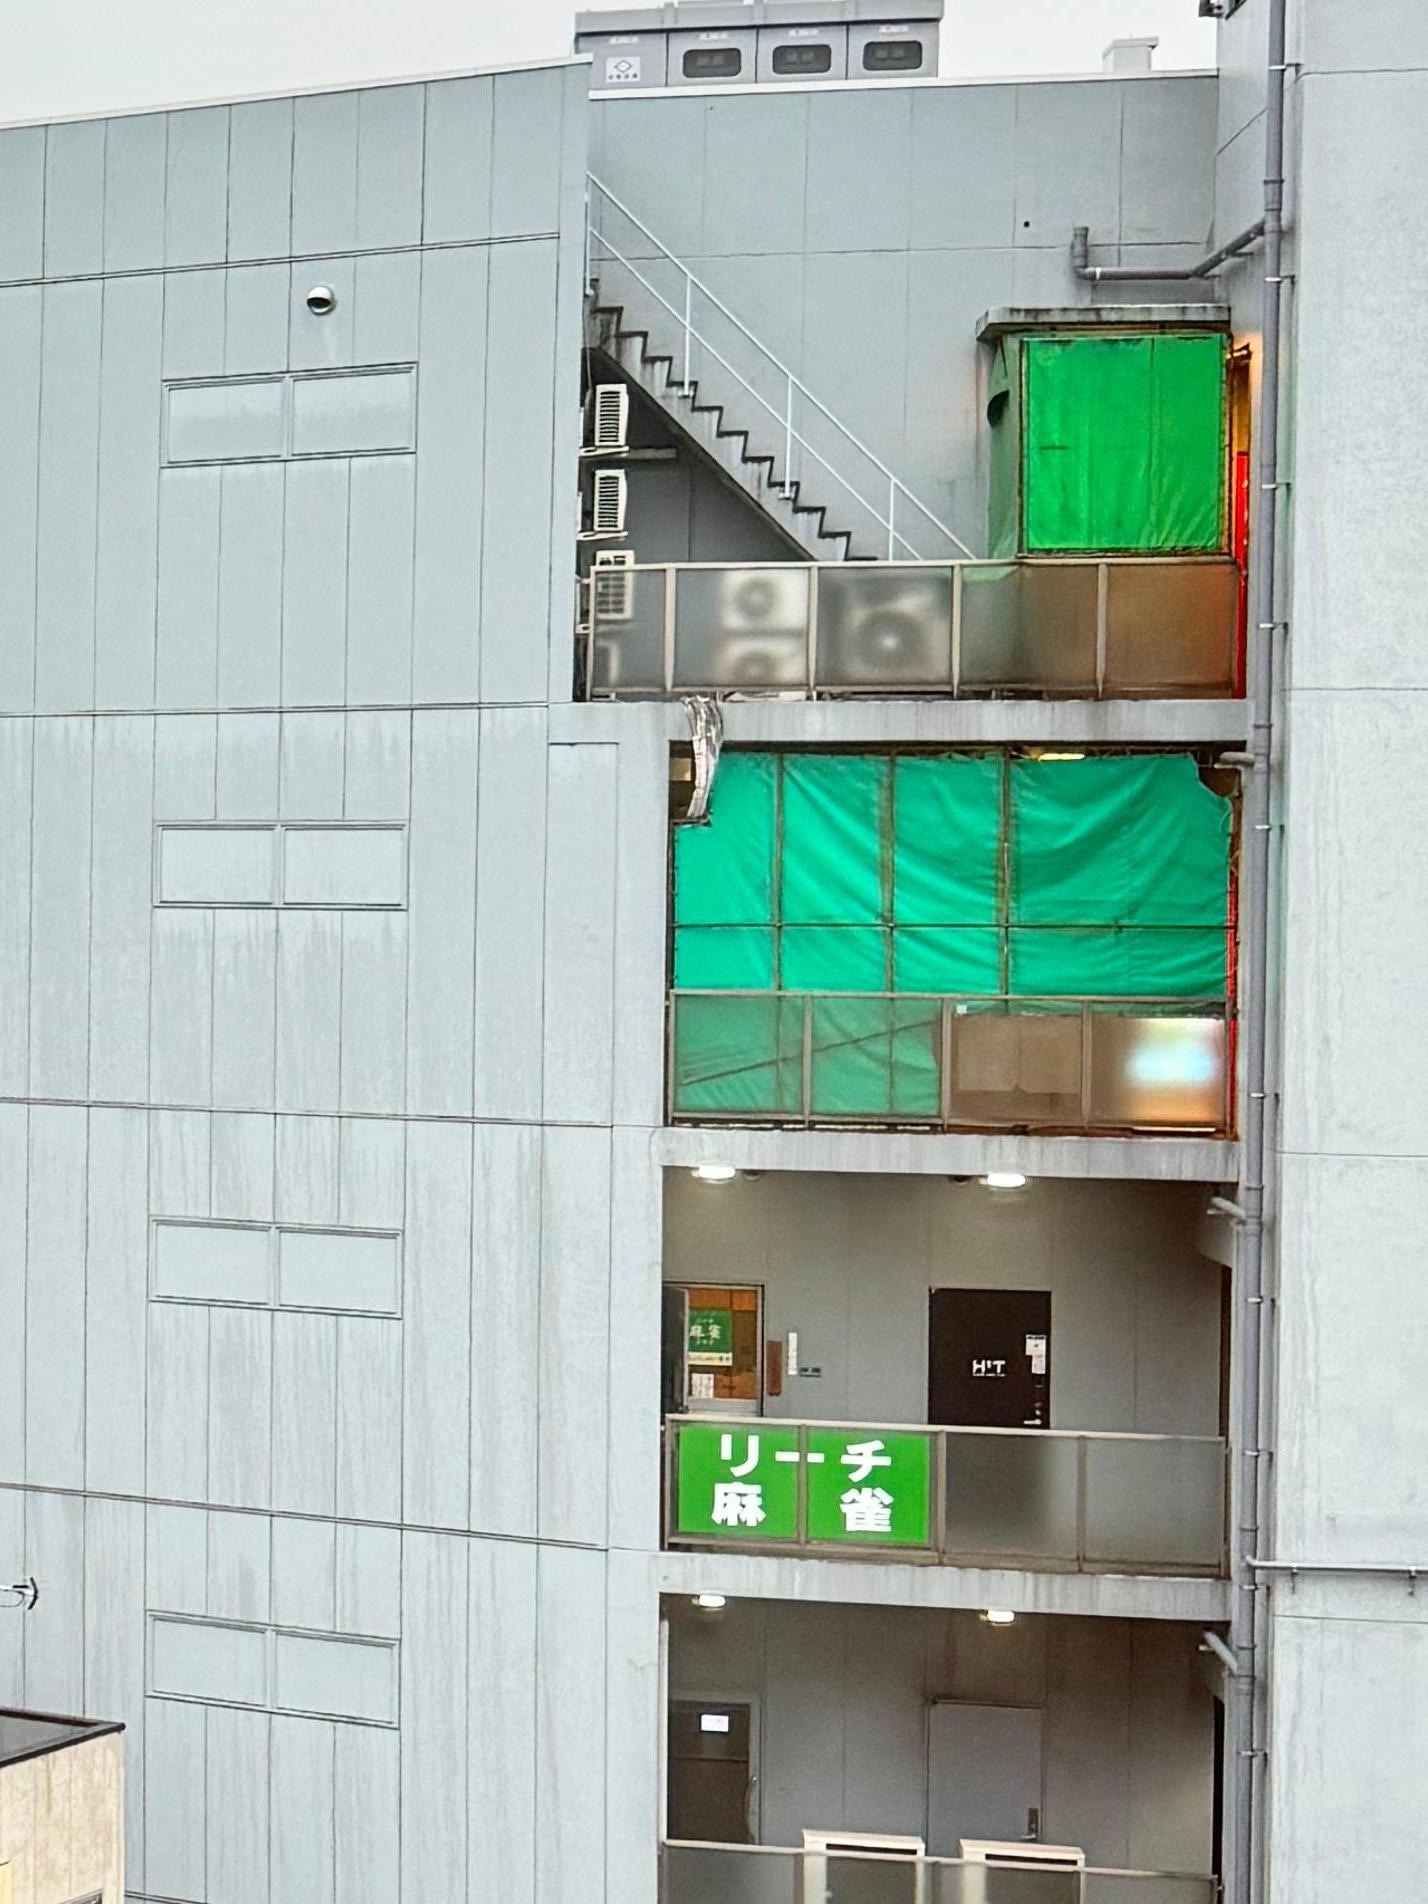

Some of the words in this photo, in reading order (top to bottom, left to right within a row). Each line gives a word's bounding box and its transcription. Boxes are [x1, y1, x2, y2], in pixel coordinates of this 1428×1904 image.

[720, 1433, 892, 1483] リーチ
[711, 1483, 892, 1534] 麻雀
